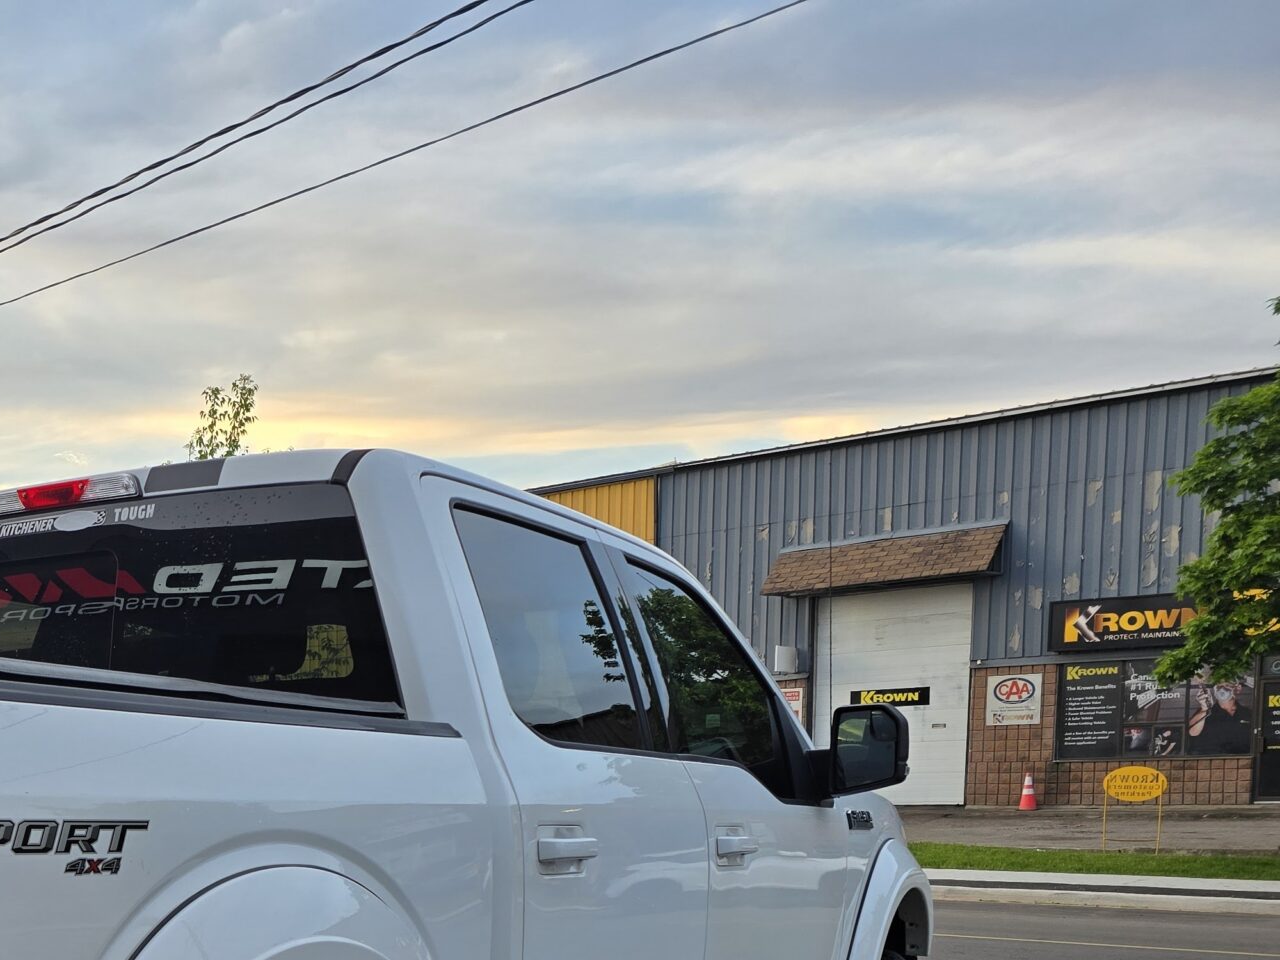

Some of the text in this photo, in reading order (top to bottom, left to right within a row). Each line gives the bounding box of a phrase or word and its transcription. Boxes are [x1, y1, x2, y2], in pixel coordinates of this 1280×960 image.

[0, 517, 55, 537] KITCHENER
[114, 504, 156, 522] TOUGH
[1066, 666, 1119, 680] KROWN
[860, 690, 919, 705] KROWN
[998, 680, 1030, 700] CAA
[1129, 690, 1181, 701] Protection
